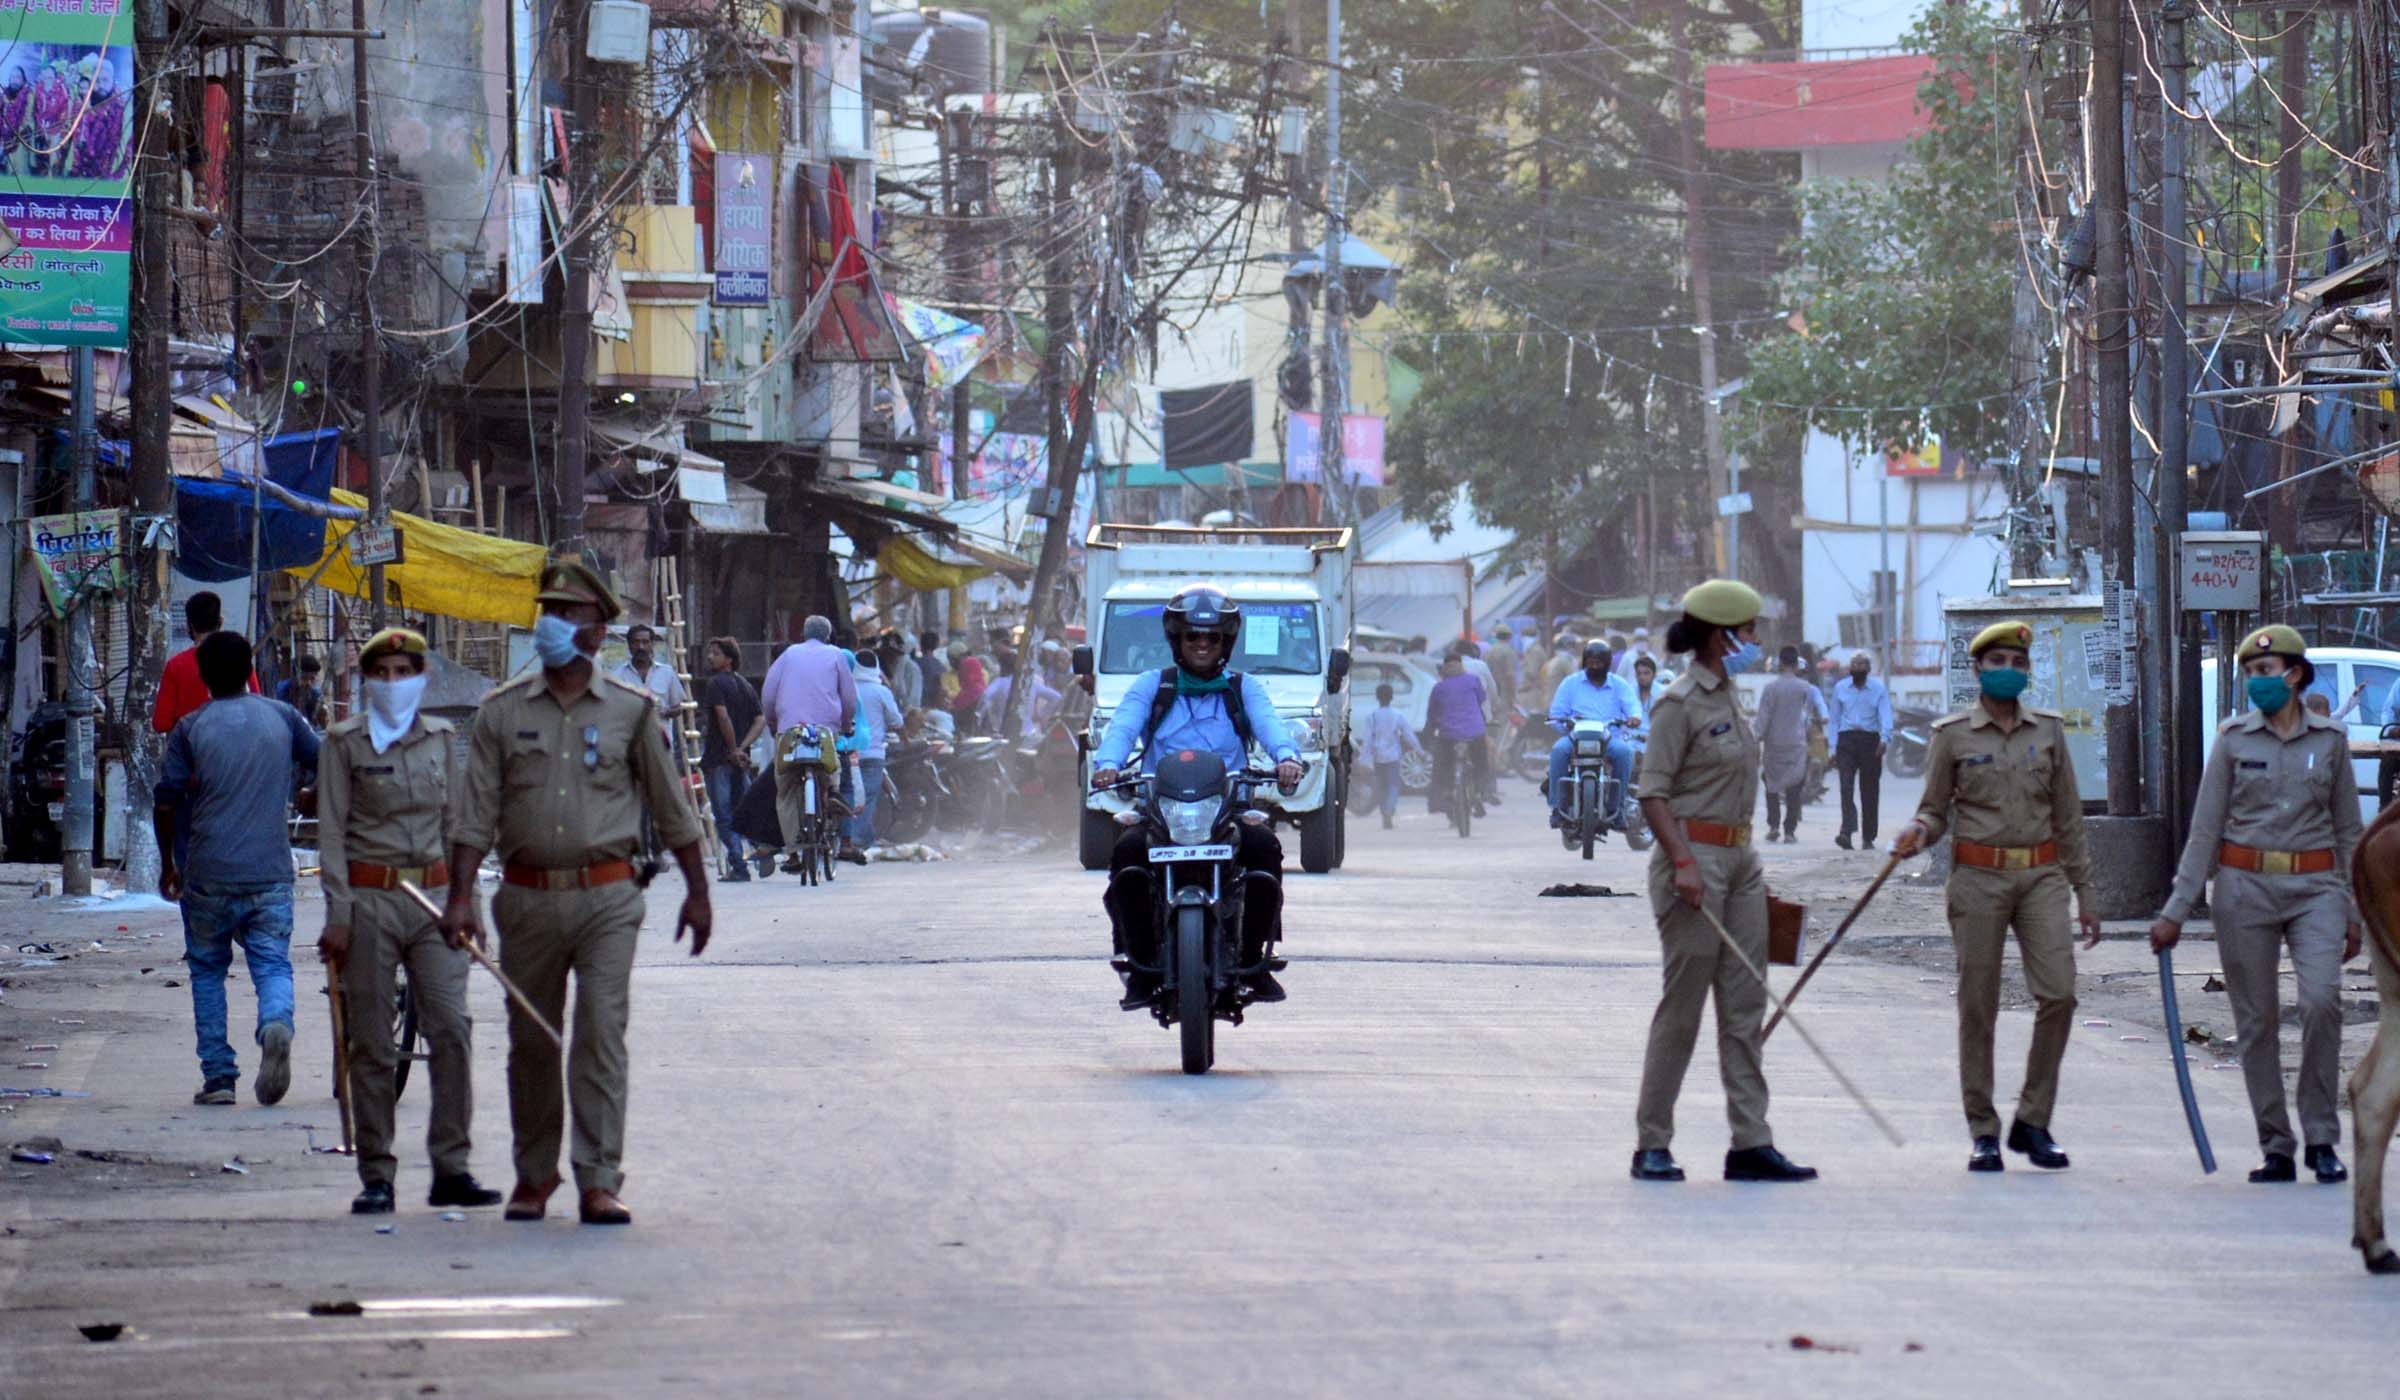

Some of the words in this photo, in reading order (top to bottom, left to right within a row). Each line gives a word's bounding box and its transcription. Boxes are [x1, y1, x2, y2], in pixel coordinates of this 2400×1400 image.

[29, 202, 67, 220] किसने
[70, 204, 99, 221] रोका
[26, 227, 45, 240] कर
[50, 224, 80, 241] लिया
